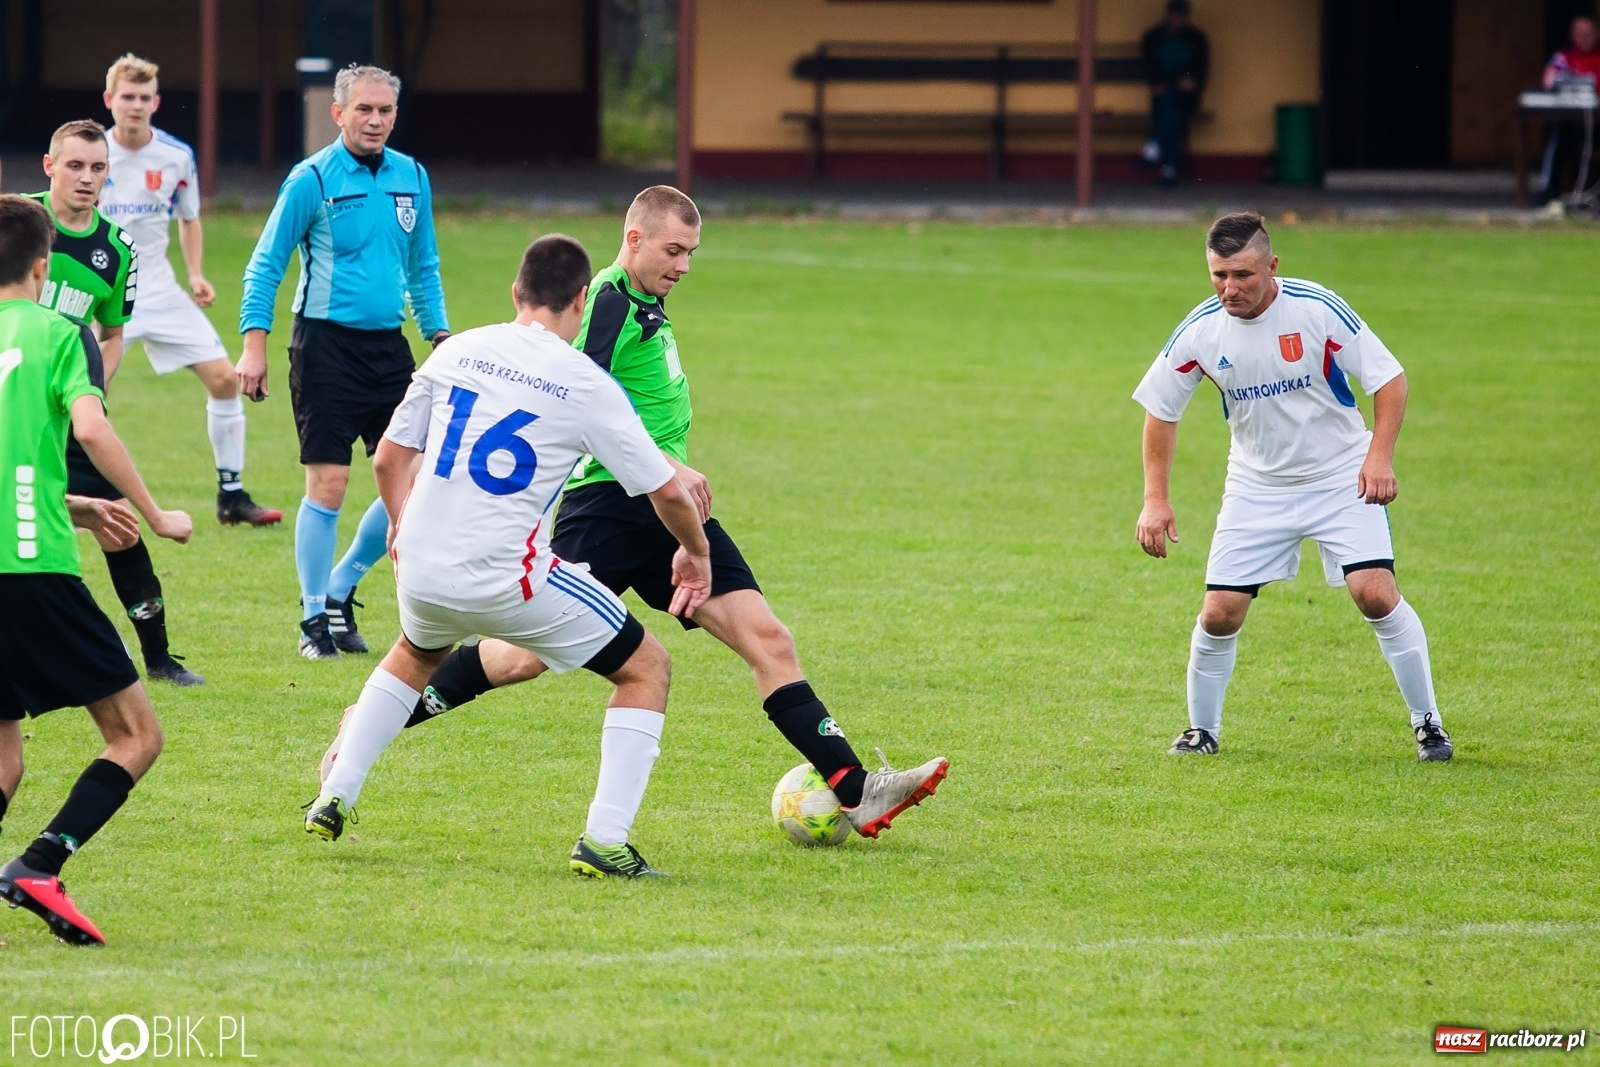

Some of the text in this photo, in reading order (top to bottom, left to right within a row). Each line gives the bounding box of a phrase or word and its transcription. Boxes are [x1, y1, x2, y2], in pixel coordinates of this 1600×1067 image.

[471, 359, 495, 375] 1905
[496, 366, 569, 400] KRZANOWICE
[434, 385, 541, 496] 16
[317, 813, 335, 825] COPA
